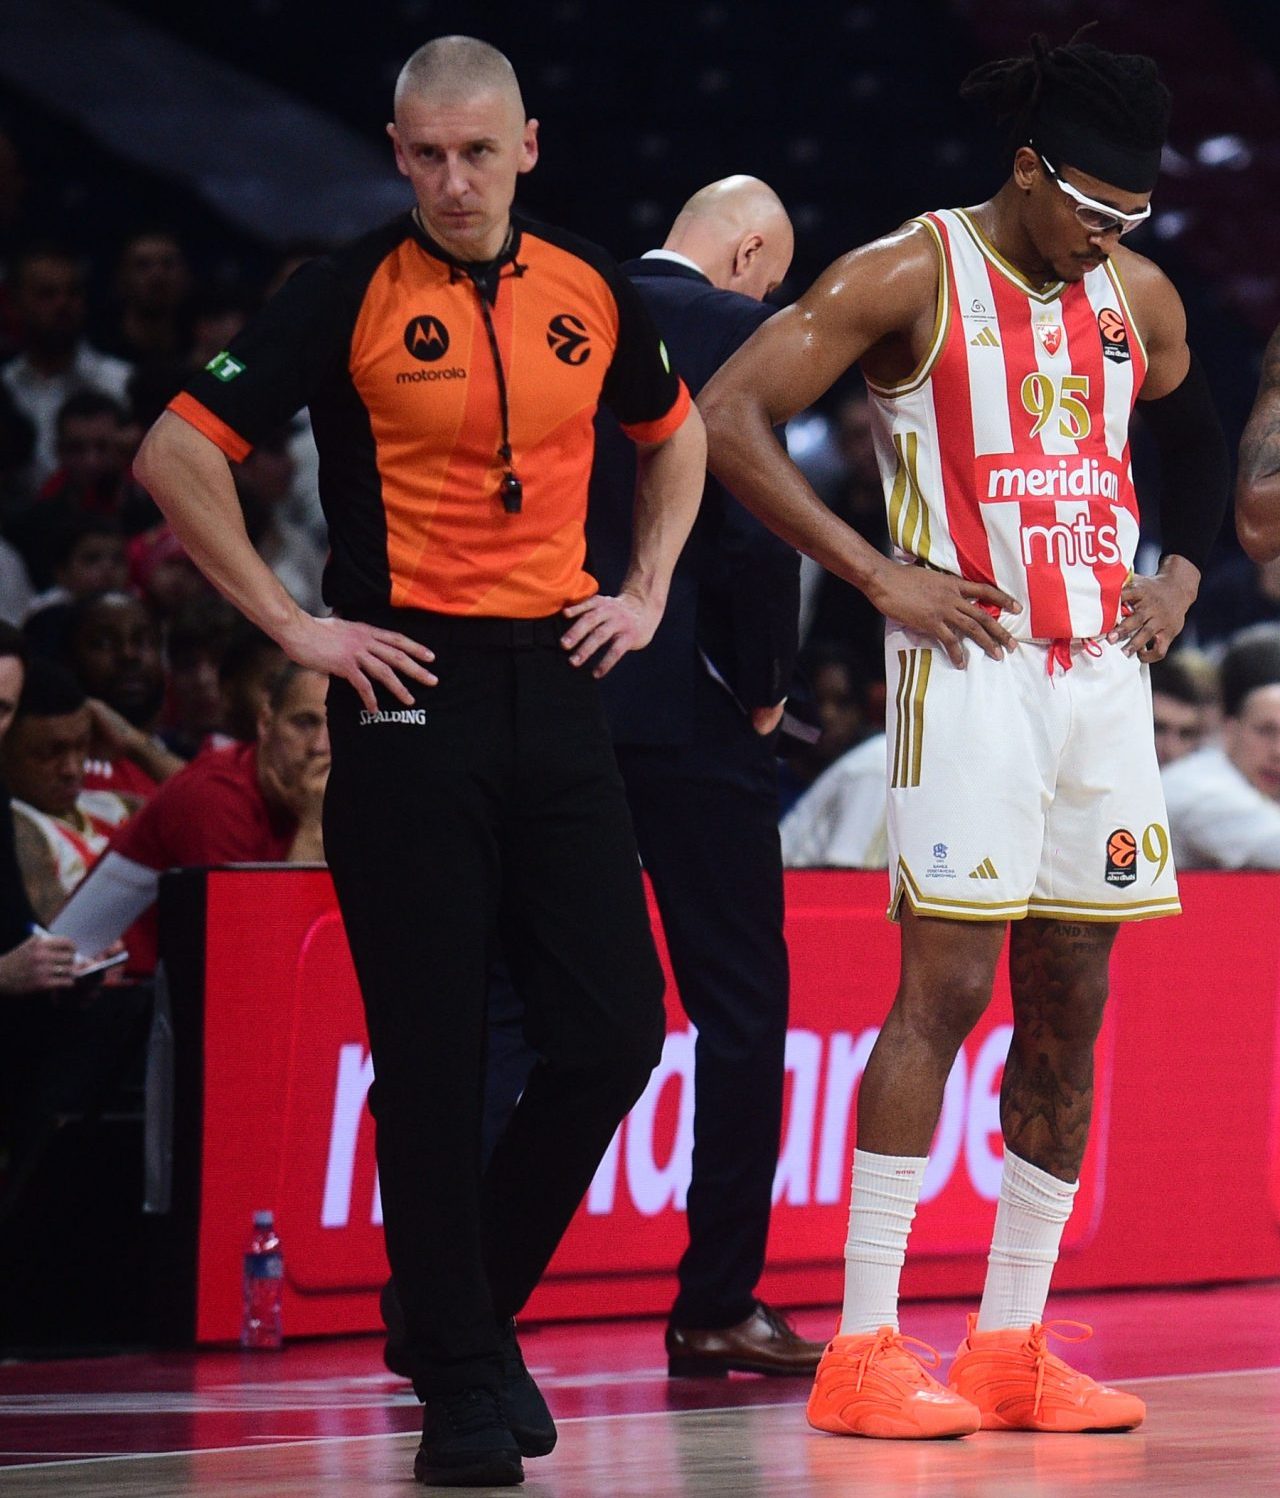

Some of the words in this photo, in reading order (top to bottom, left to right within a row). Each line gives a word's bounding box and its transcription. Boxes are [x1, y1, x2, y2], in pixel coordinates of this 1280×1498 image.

[396, 366, 467, 384] motorola
[1020, 372, 1092, 440] 95
[987, 458, 1119, 502] meridian
[1021, 513, 1121, 565] mts
[360, 709, 427, 725] SPALDING
[1141, 823, 1172, 886] 9
